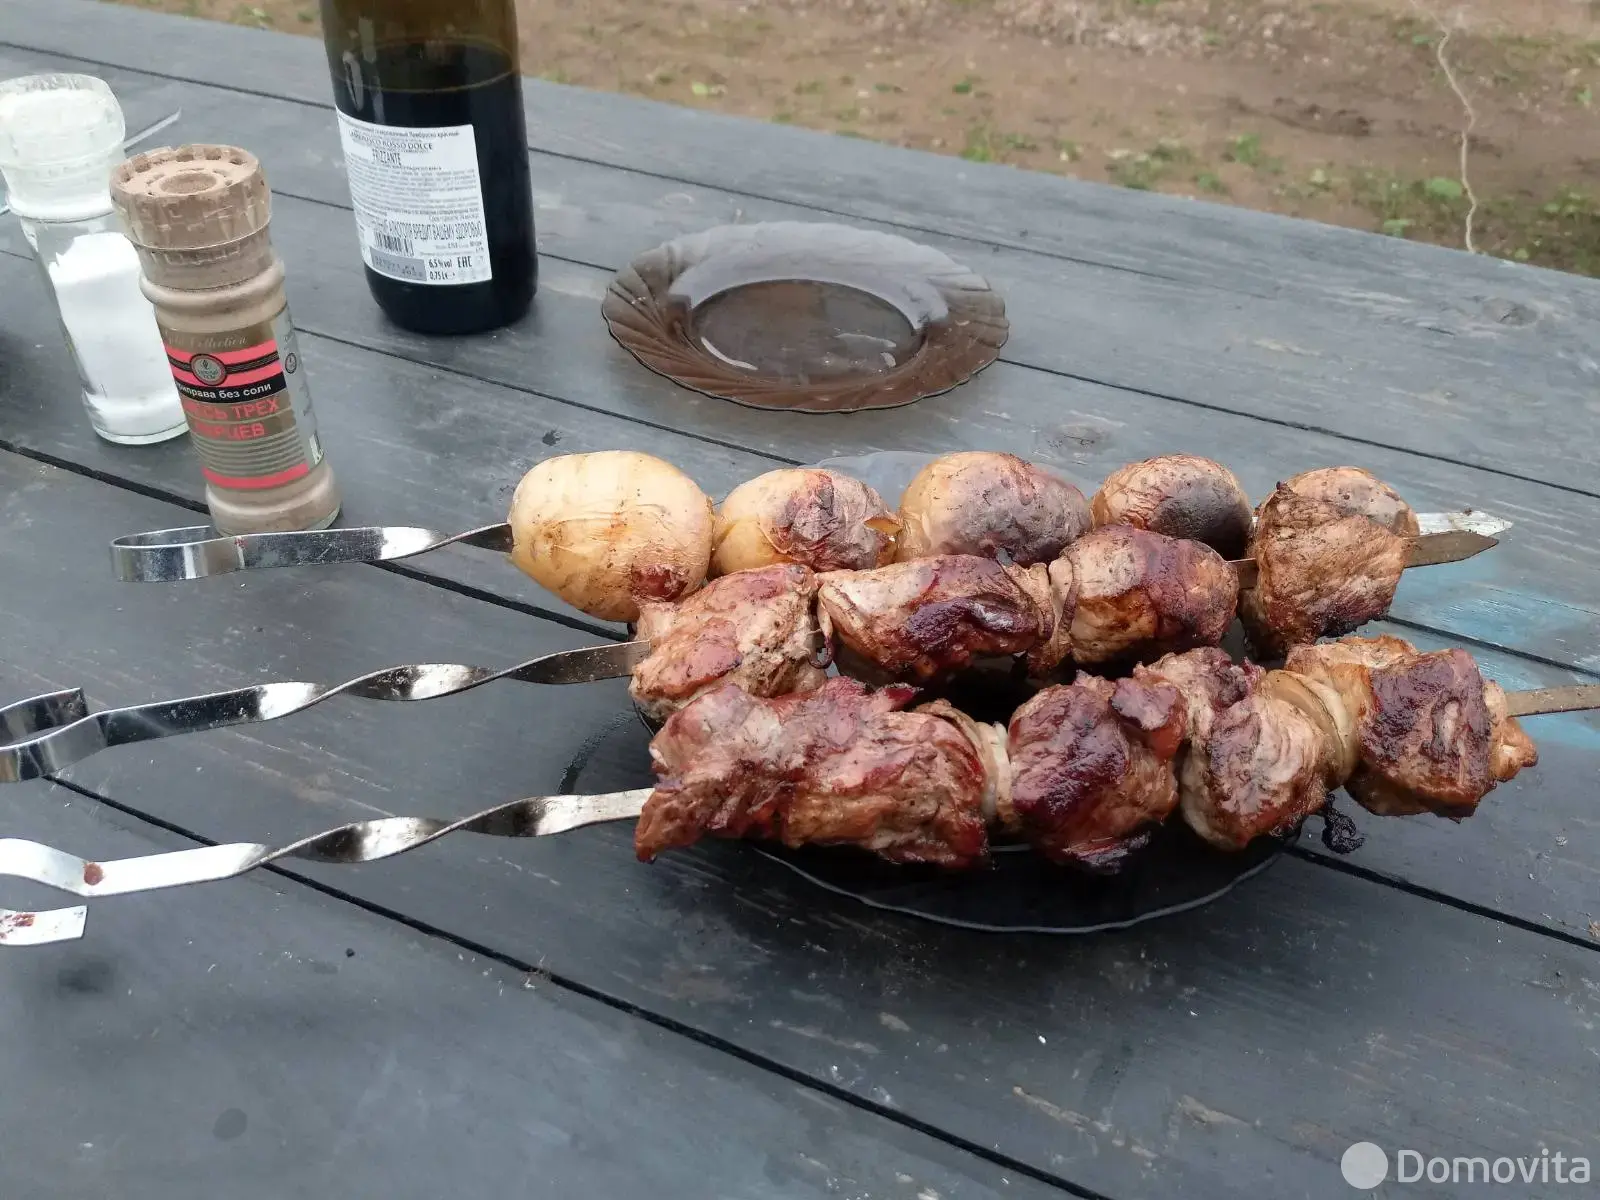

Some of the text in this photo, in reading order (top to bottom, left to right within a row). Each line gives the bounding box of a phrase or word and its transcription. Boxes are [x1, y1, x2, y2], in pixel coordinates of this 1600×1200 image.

[407, 142, 433, 150] DOLCE
[219, 390, 240, 399] без
[243, 383, 272, 396] соли
[231, 398, 279, 420] ТРЕХ
